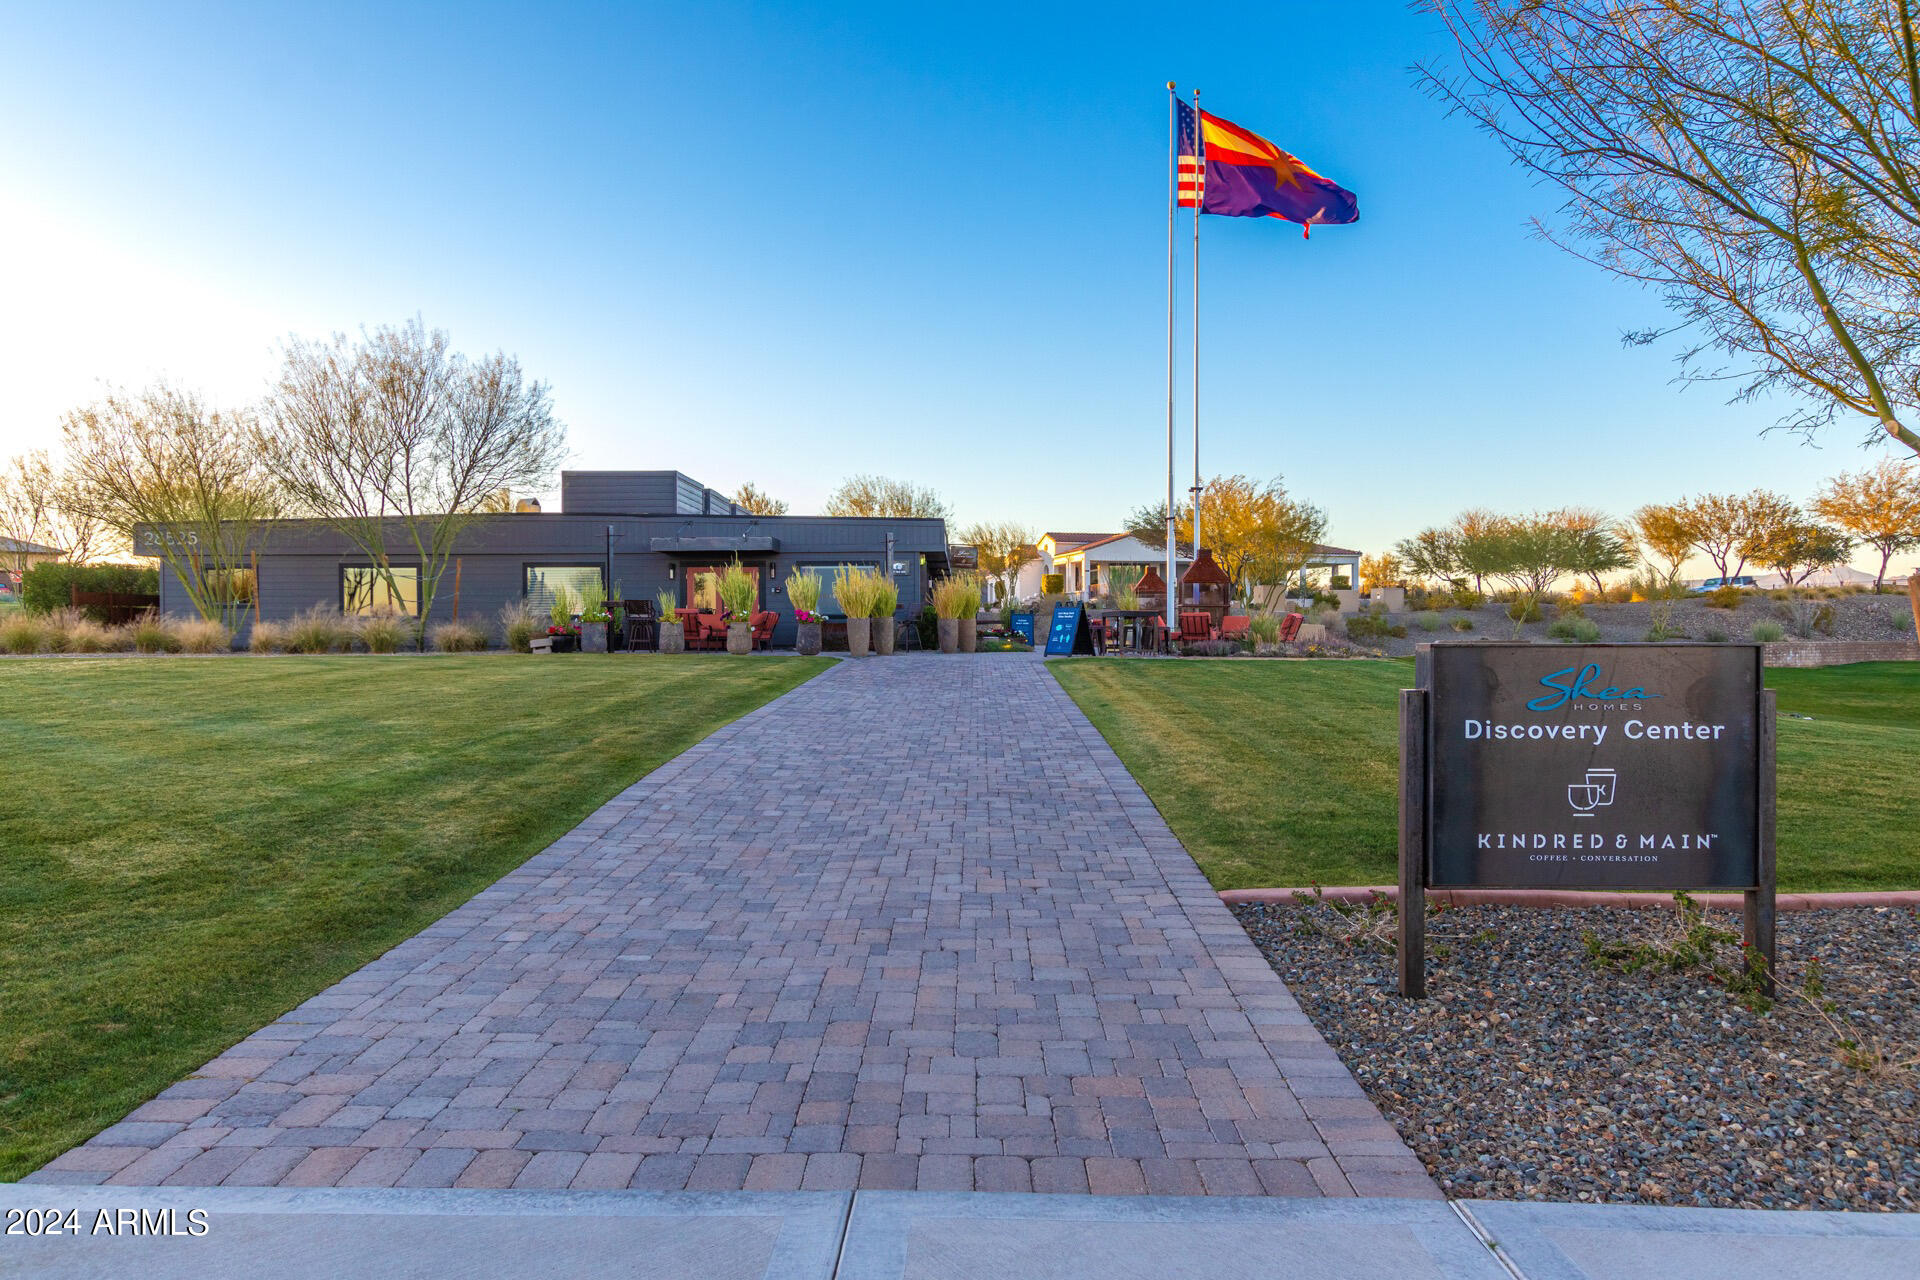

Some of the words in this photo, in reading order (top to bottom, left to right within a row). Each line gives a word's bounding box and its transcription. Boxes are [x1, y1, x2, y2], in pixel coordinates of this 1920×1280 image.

[1526, 663, 1664, 712] Shea
[1573, 703, 1642, 711] HOMES
[1464, 719, 1608, 746] Discovery
[1623, 719, 1726, 740] Center
[1478, 833, 1604, 849] KINDRED
[1615, 833, 1628, 849] &
[1529, 854, 1569, 862] COFFEE
[1580, 854, 1658, 862] CONVERSATION
